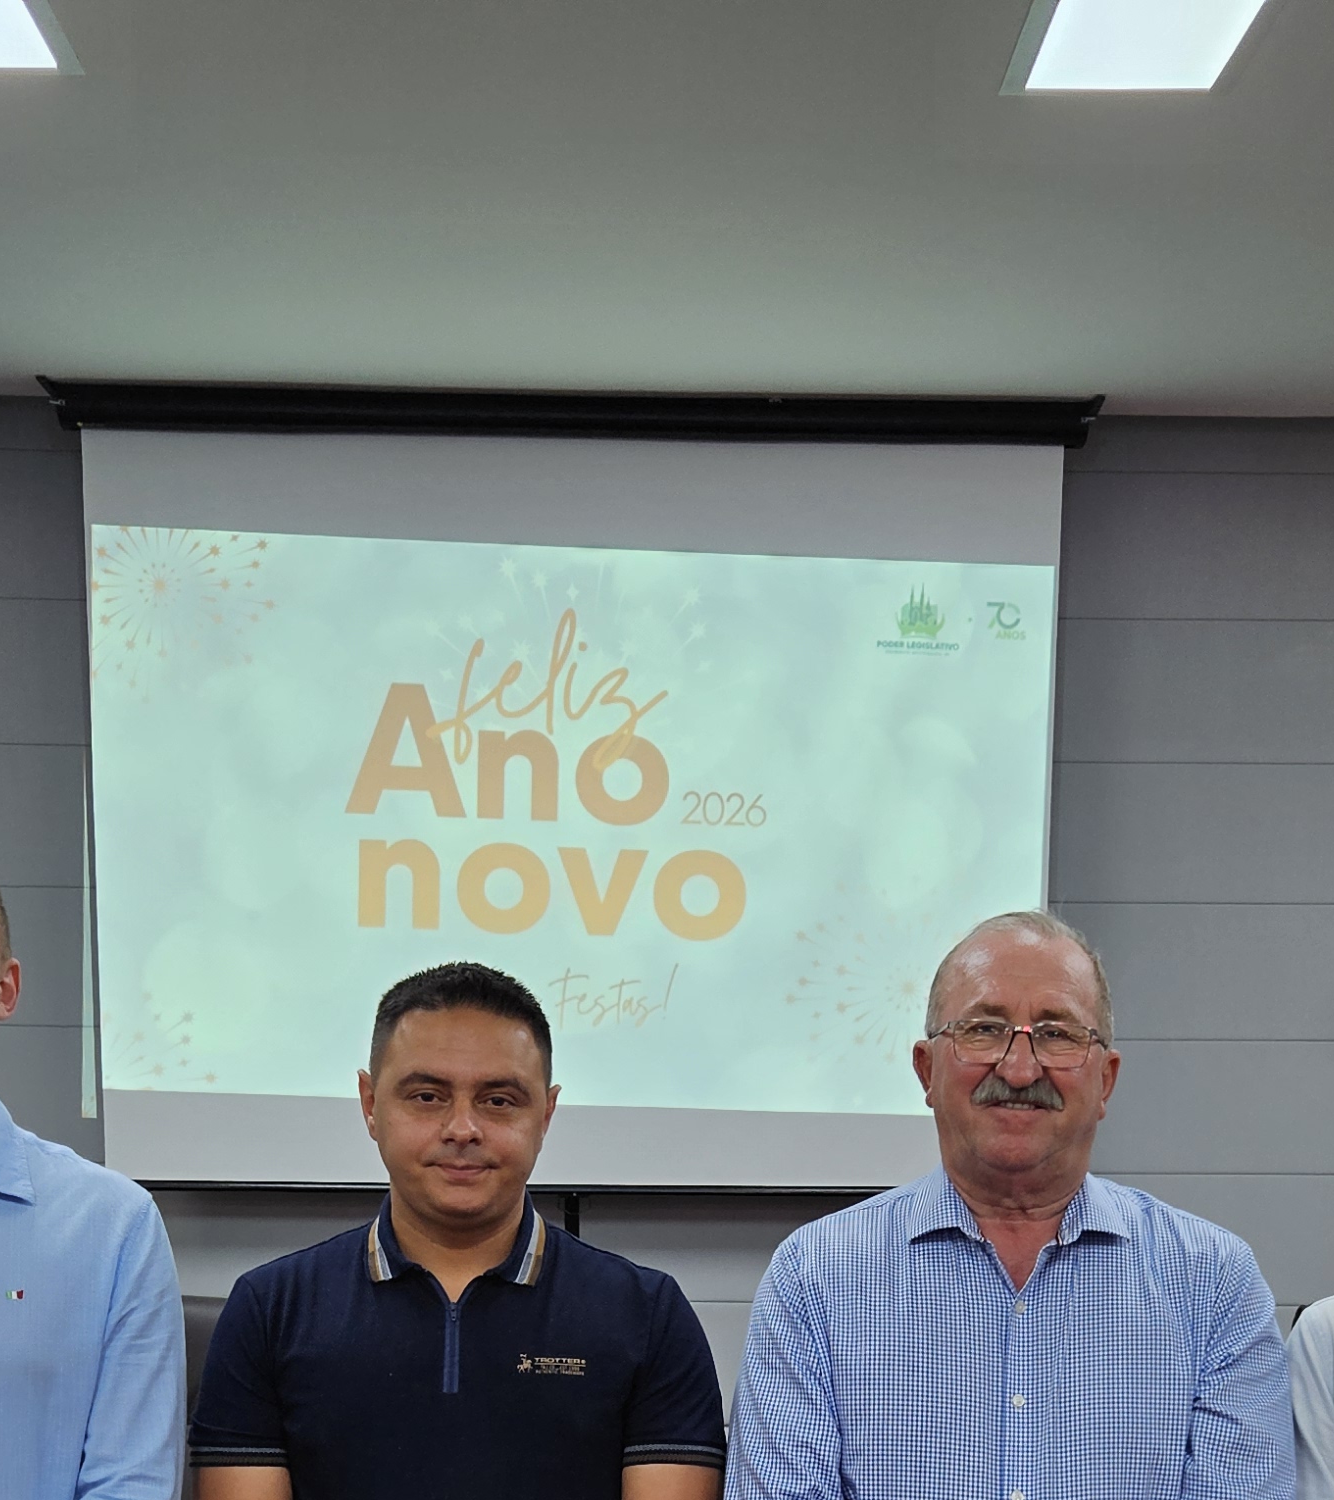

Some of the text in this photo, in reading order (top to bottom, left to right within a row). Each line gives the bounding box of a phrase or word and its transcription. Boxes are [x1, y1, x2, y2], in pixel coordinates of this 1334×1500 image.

[876, 640, 960, 651] PODER LEGISLATIVO
[995, 630, 1026, 641] ANOS
[426, 608, 668, 770] feliz
[344, 682, 767, 827] Ano 2026
[357, 838, 747, 942] novo
[548, 962, 679, 1030] Festas!
